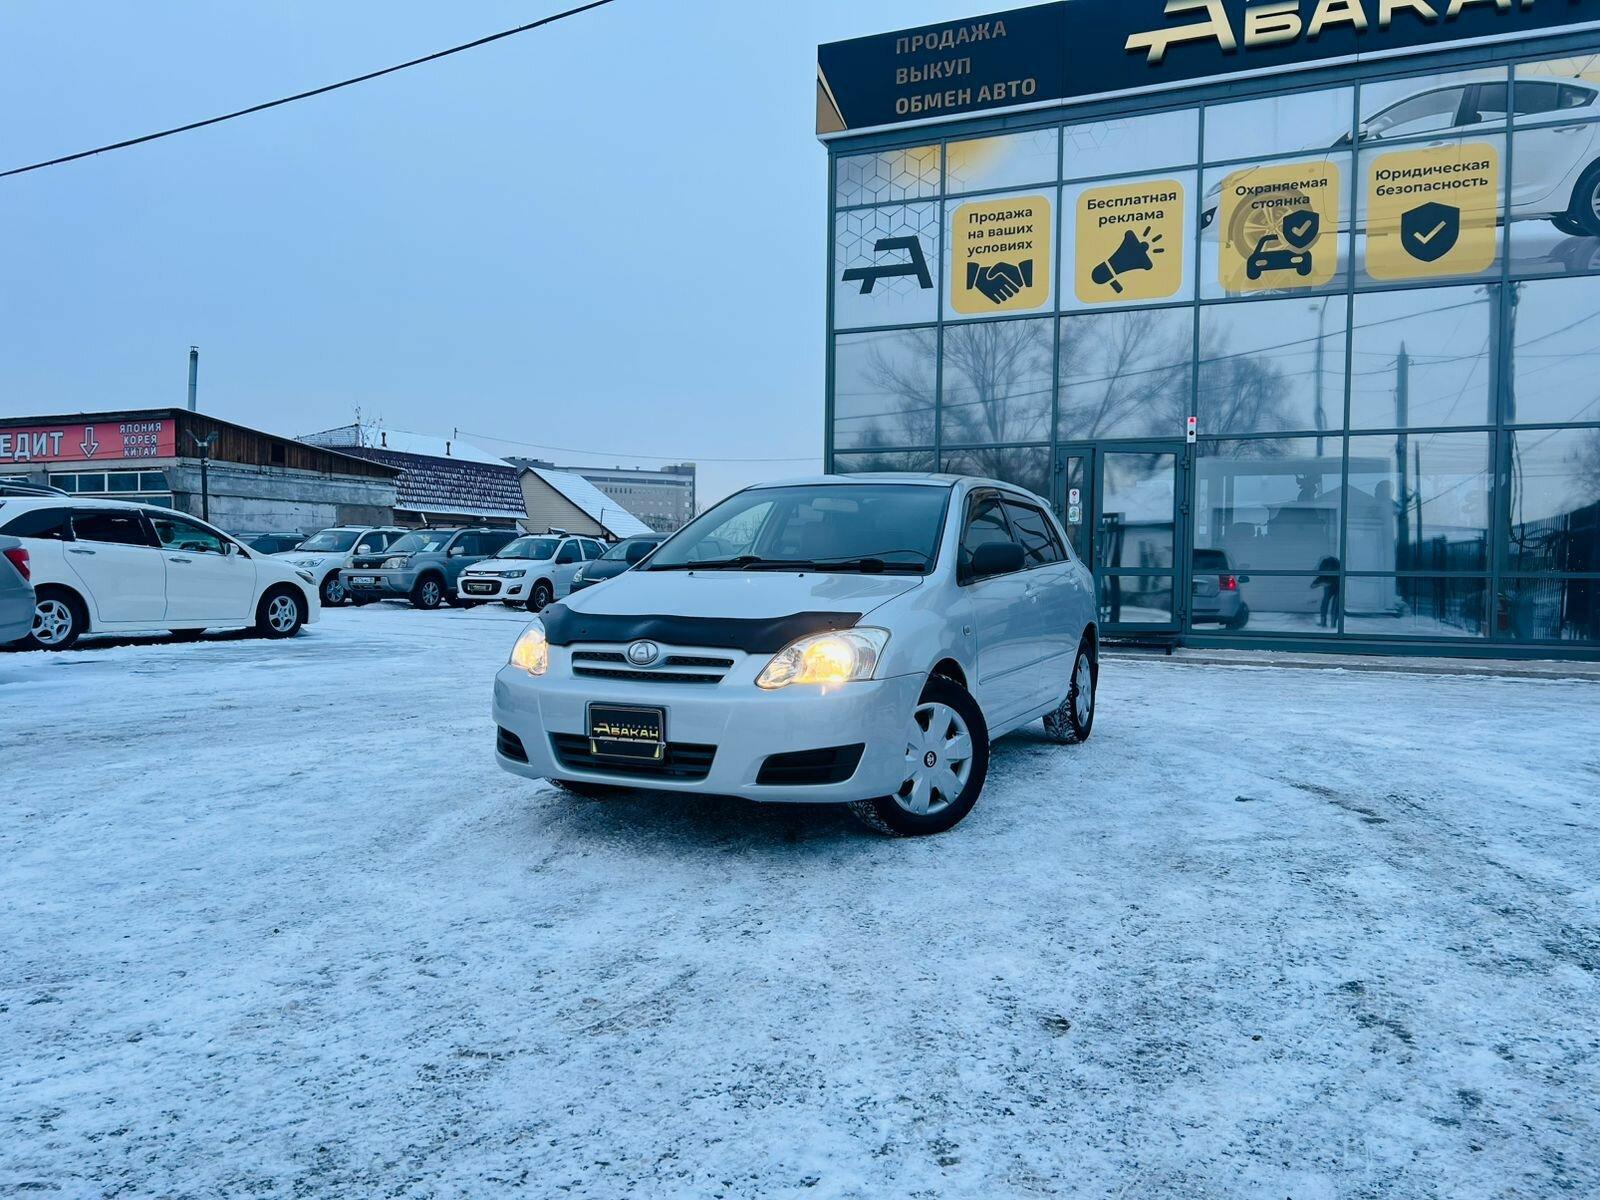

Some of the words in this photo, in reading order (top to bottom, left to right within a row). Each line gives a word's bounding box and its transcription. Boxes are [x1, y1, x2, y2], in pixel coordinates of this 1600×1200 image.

[896, 20, 1006, 54] ПРОДАЖА
[896, 57, 971, 85] ВЫКУП
[895, 87, 971, 115] ОБМЕН
[977, 78, 1036, 103] АВТО
[1375, 160, 1489, 181] Юридическая
[1235, 178, 1327, 196] Охраняемая
[1376, 177, 1488, 196] безопасность
[1087, 191, 1177, 210] Бесплатная
[1251, 195, 1310, 209] стоянка
[969, 208, 1033, 225] Продажа
[1098, 210, 1164, 228] реклама
[968, 230, 984, 240] на
[988, 224, 1033, 238] ваших
[967, 240, 1033, 258] условиях
[119, 422, 162, 434] ЯПОНИЯ
[123, 434, 157, 445] КОРЕЯ
[124, 445, 157, 457] КИТАЙ
